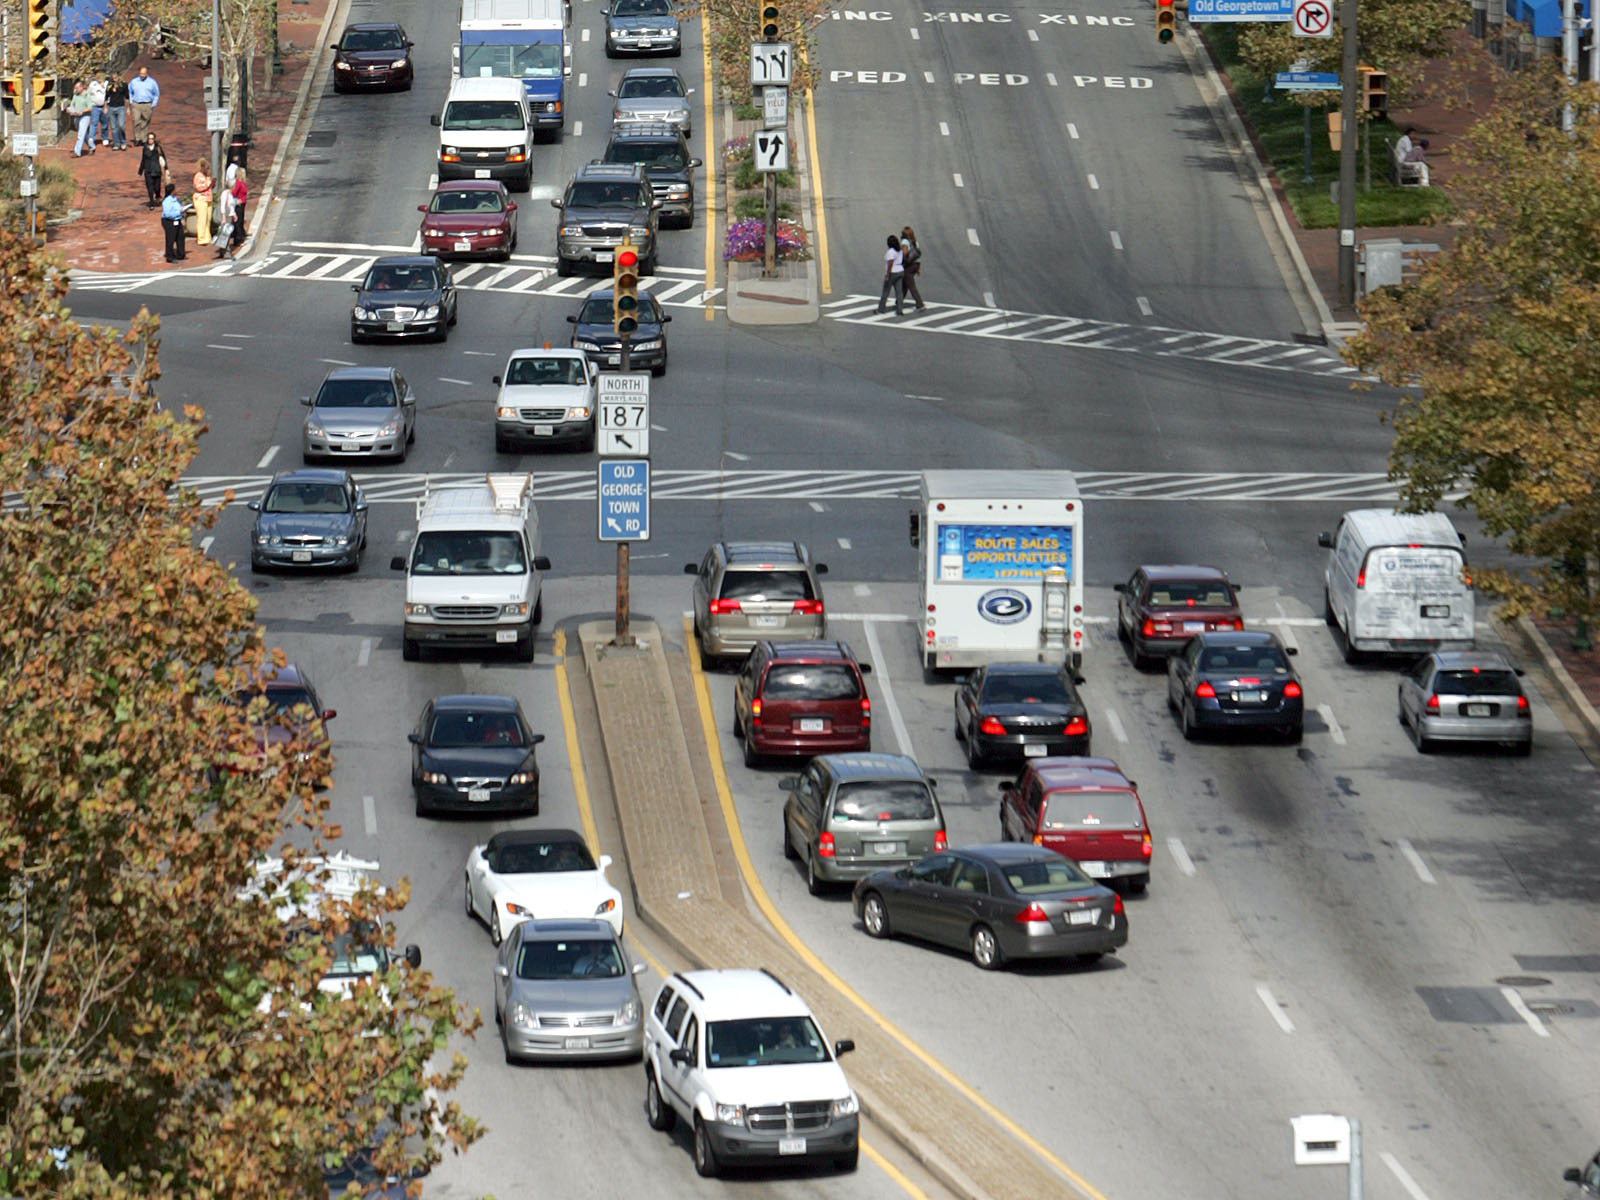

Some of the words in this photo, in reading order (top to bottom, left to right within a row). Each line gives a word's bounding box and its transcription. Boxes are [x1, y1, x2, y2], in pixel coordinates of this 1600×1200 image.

[1195, 0, 1214, 12] Old
[1215, 0, 1279, 14] Georgetown
[1281, 0, 1292, 9] Rd
[829, 70, 907, 84] PED
[954, 72, 1030, 86] PED
[1072, 74, 1154, 90] PED
[607, 379, 641, 390] NORTH
[602, 406, 645, 427] 187
[613, 465, 635, 479] OLD
[601, 483, 647, 497] GEORGE-
[608, 501, 640, 514] TOWN
[625, 518, 640, 532] RD
[975, 538, 1017, 550] ROUTE
[1021, 538, 1059, 550] SALES
[967, 551, 1068, 564] OPPORTUNITIES
